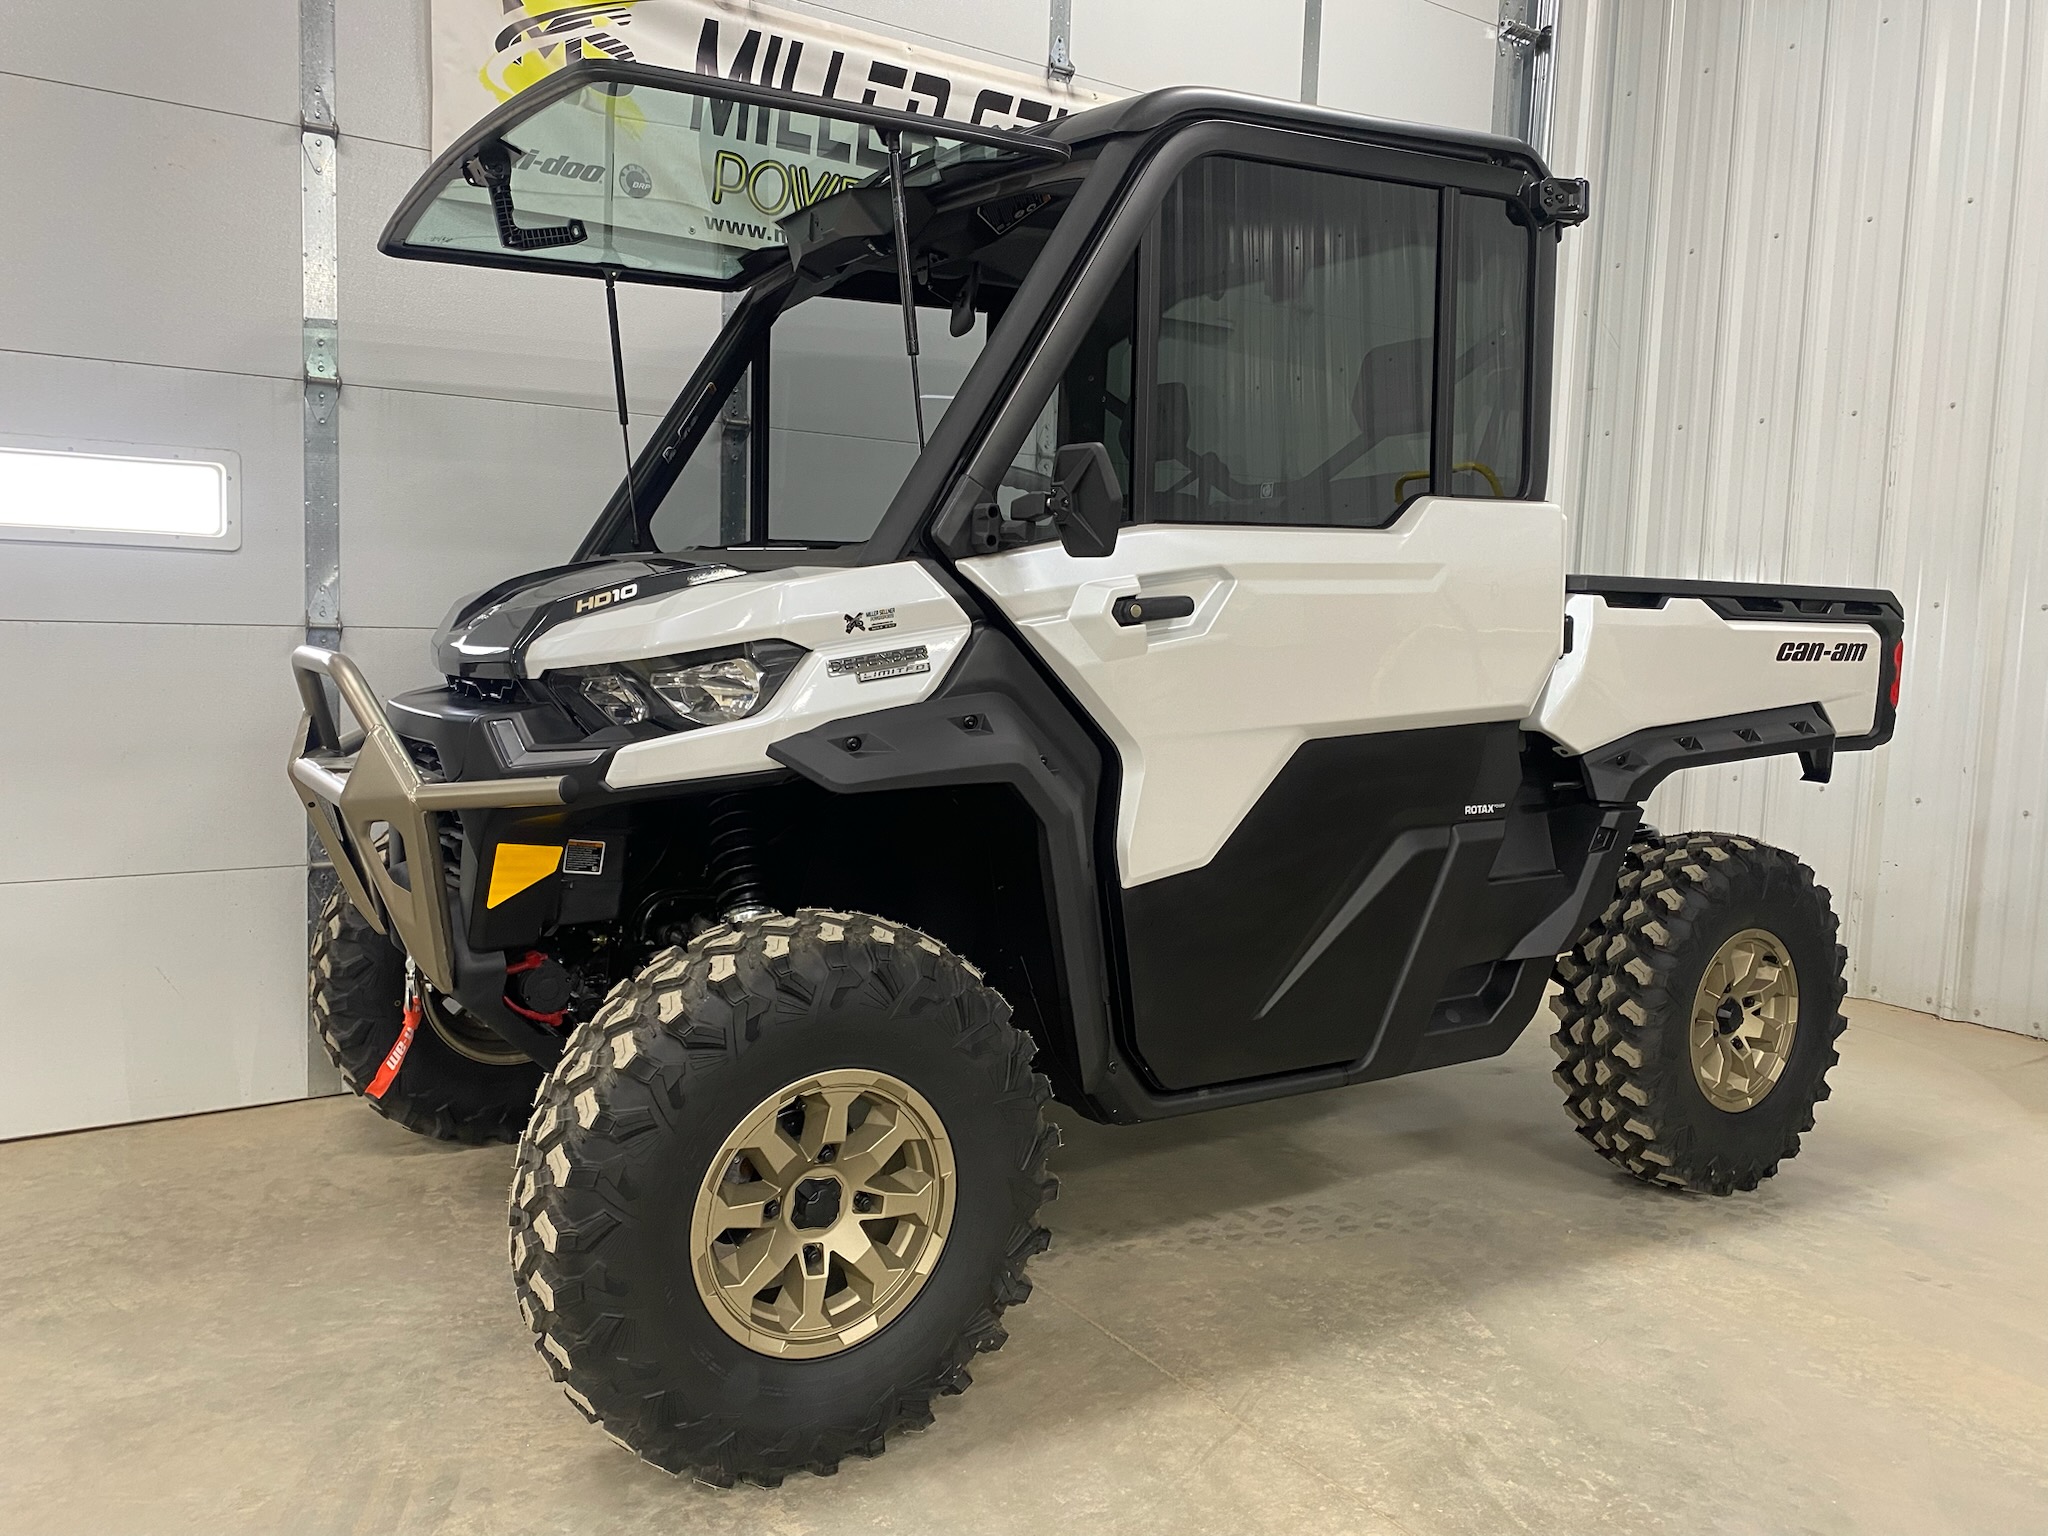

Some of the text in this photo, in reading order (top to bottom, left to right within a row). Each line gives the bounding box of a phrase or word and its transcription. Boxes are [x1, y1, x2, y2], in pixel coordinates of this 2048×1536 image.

[513, 149, 606, 182] i-doo
[632, 181, 651, 190] BRP
[712, 150, 862, 216] POW
[575, 583, 638, 613] HD10
[827, 646, 928, 673] DEFENDER
[1776, 642, 1868, 661] can-am
[863, 664, 925, 679] LIMITED
[1464, 804, 1495, 815] ROTAX
[386, 1027, 414, 1071] n-am
